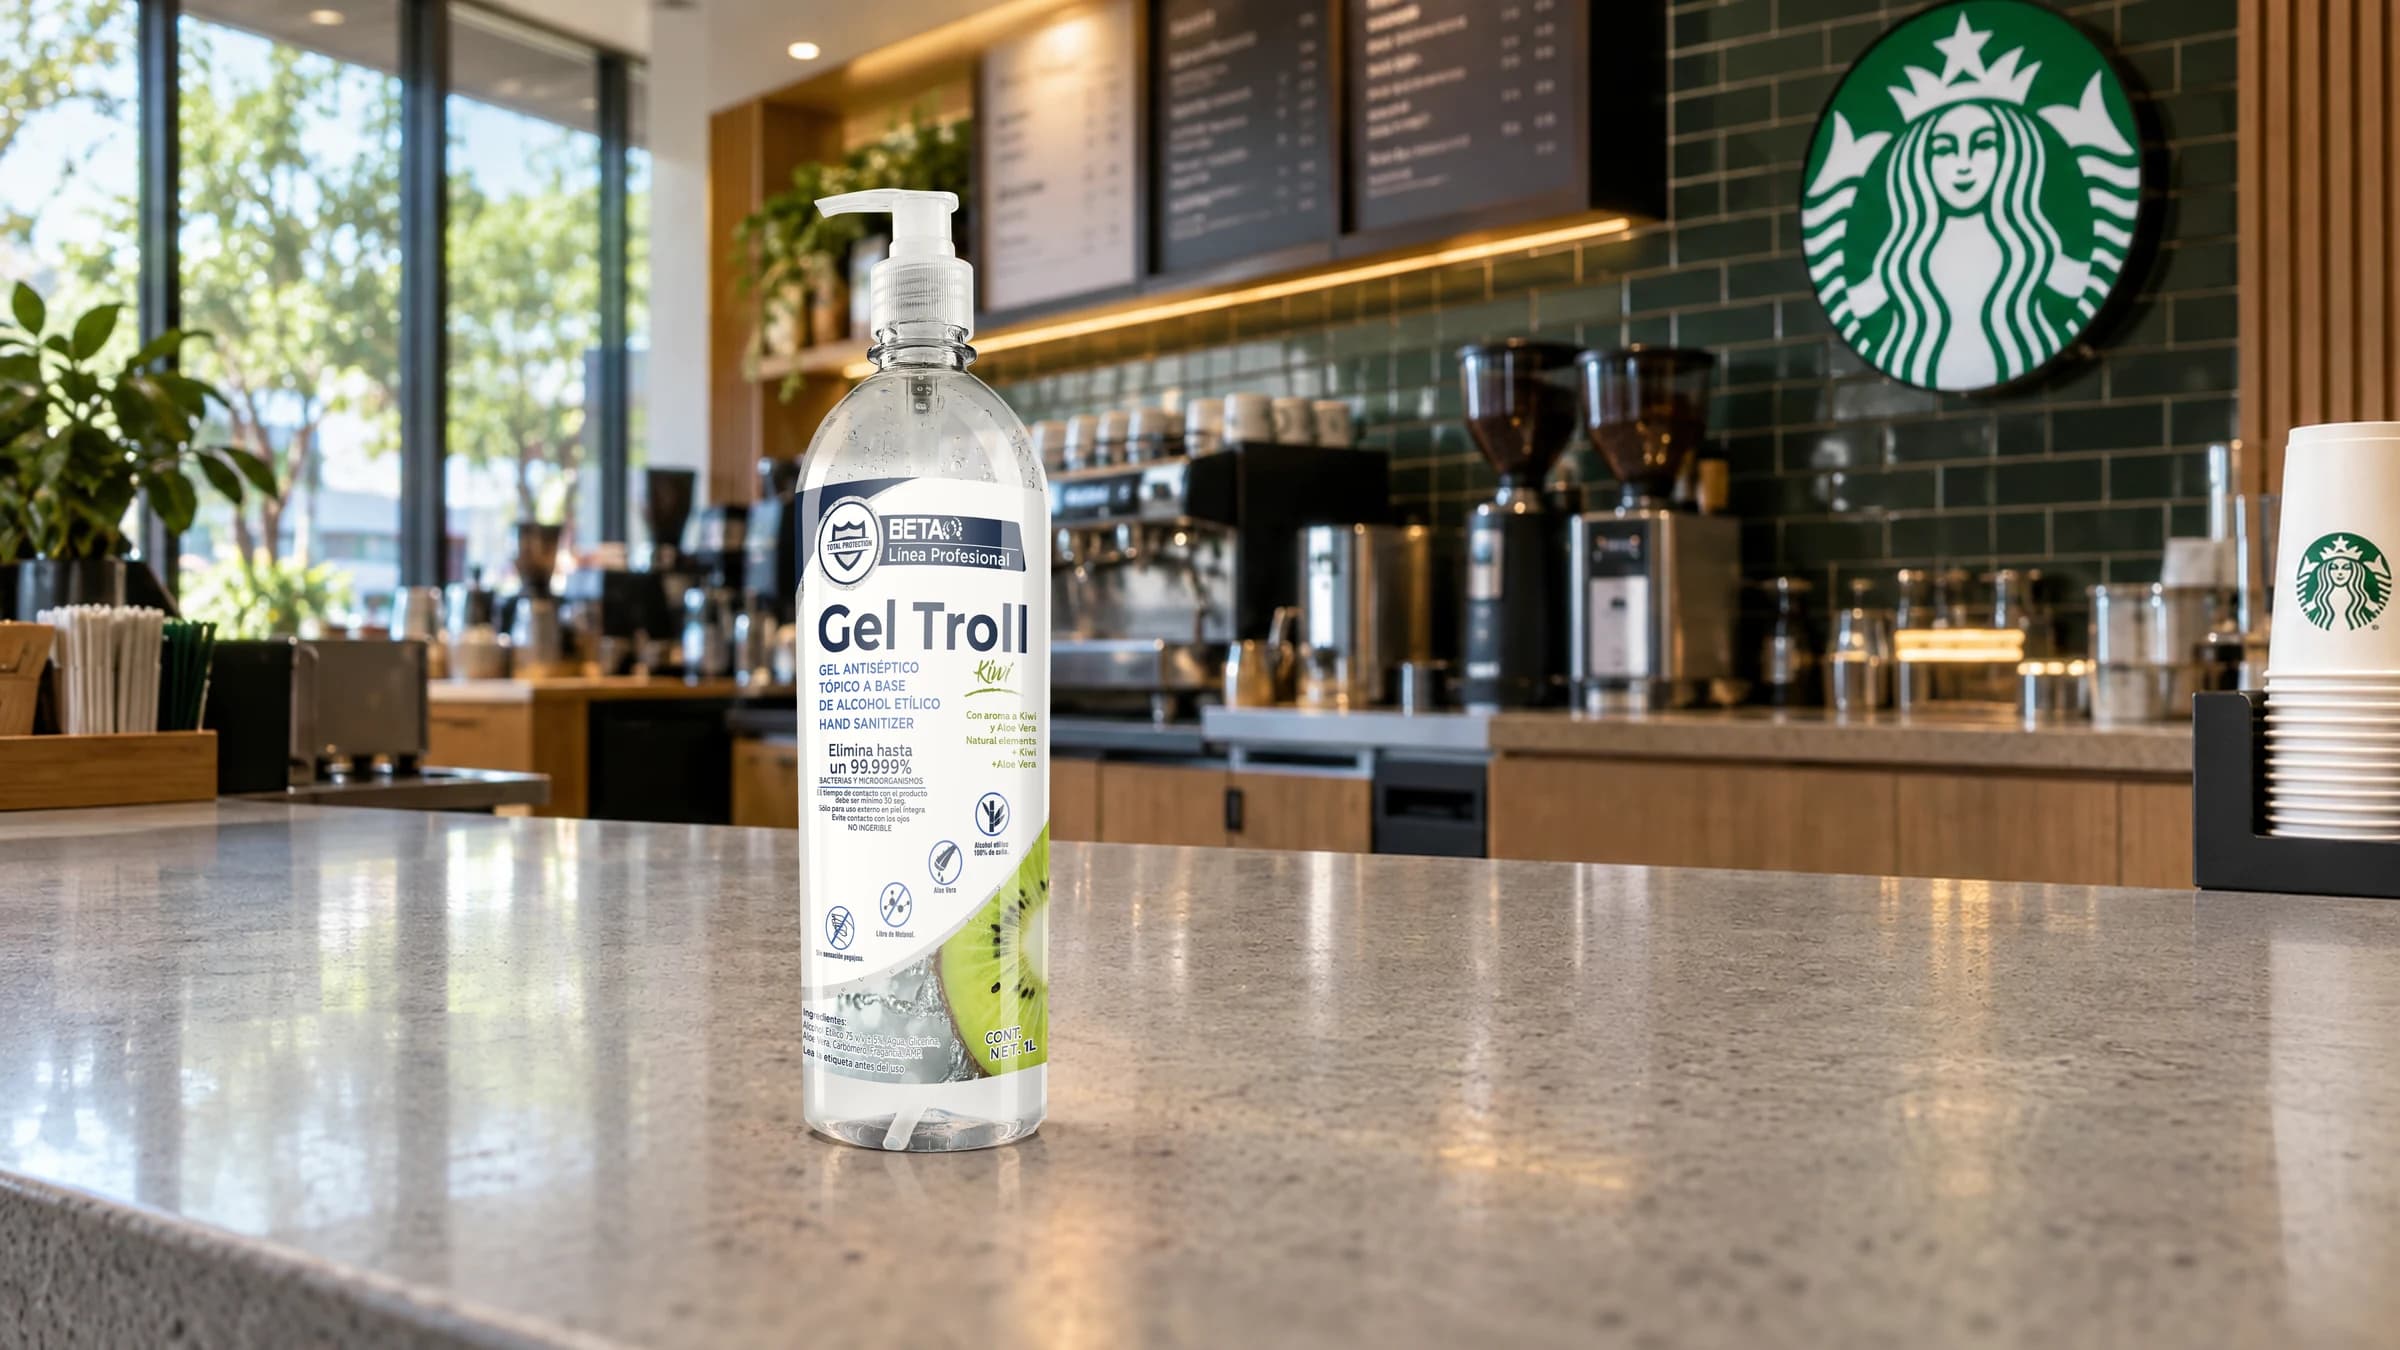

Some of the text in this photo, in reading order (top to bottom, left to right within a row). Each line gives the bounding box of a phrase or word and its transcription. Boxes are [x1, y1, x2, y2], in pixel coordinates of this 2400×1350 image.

[890, 518, 944, 540] BETA
[826, 540, 872, 551] TOTAL PROTECTION
[889, 548, 1010, 567] Línea Profesional
[818, 599, 1028, 654] Gel Troll
[819, 659, 920, 676] GEL ANTISÉPTICO
[973, 659, 1015, 684] Kiwi
[819, 679, 906, 694] TÓPICO A BASE
[820, 695, 941, 711] DE ALCOHOL ETÍLICO
[966, 710, 982, 720] Con
[984, 712, 1010, 720] aroma
[1019, 712, 1037, 721] Kiwi
[820, 718, 914, 730] HAND SANITIZER
[990, 723, 1037, 734] y Aloe Vera
[966, 736, 1037, 746] Natural elements
[828, 743, 912, 757] Elimina hasta
[1019, 748, 1037, 757] Kiwi
[830, 758, 912, 774] un 99.999%
[1018, 760, 1037, 768] Vera
[818, 776, 852, 784] BACTERIAS
[858, 776, 924, 784] MICROORGANISMOS
[823, 789, 843, 798] tiempo
[899, 790, 928, 799] producto
[832, 806, 844, 814] para
[890, 806, 902, 814] piel
[896, 816, 910, 824] ojos
[858, 824, 892, 832] INGERIBLE
[803, 1008, 847, 1026] Ingredientes:
[846, 1032, 853, 1040] 75
[986, 1026, 1022, 1044] CONT.
[990, 1040, 1036, 1060] NET. 1L
[803, 1046, 814, 1057] Lea
[824, 1054, 853, 1068] etiqueta
[854, 1062, 874, 1072] antes
[876, 1063, 888, 1072] del
